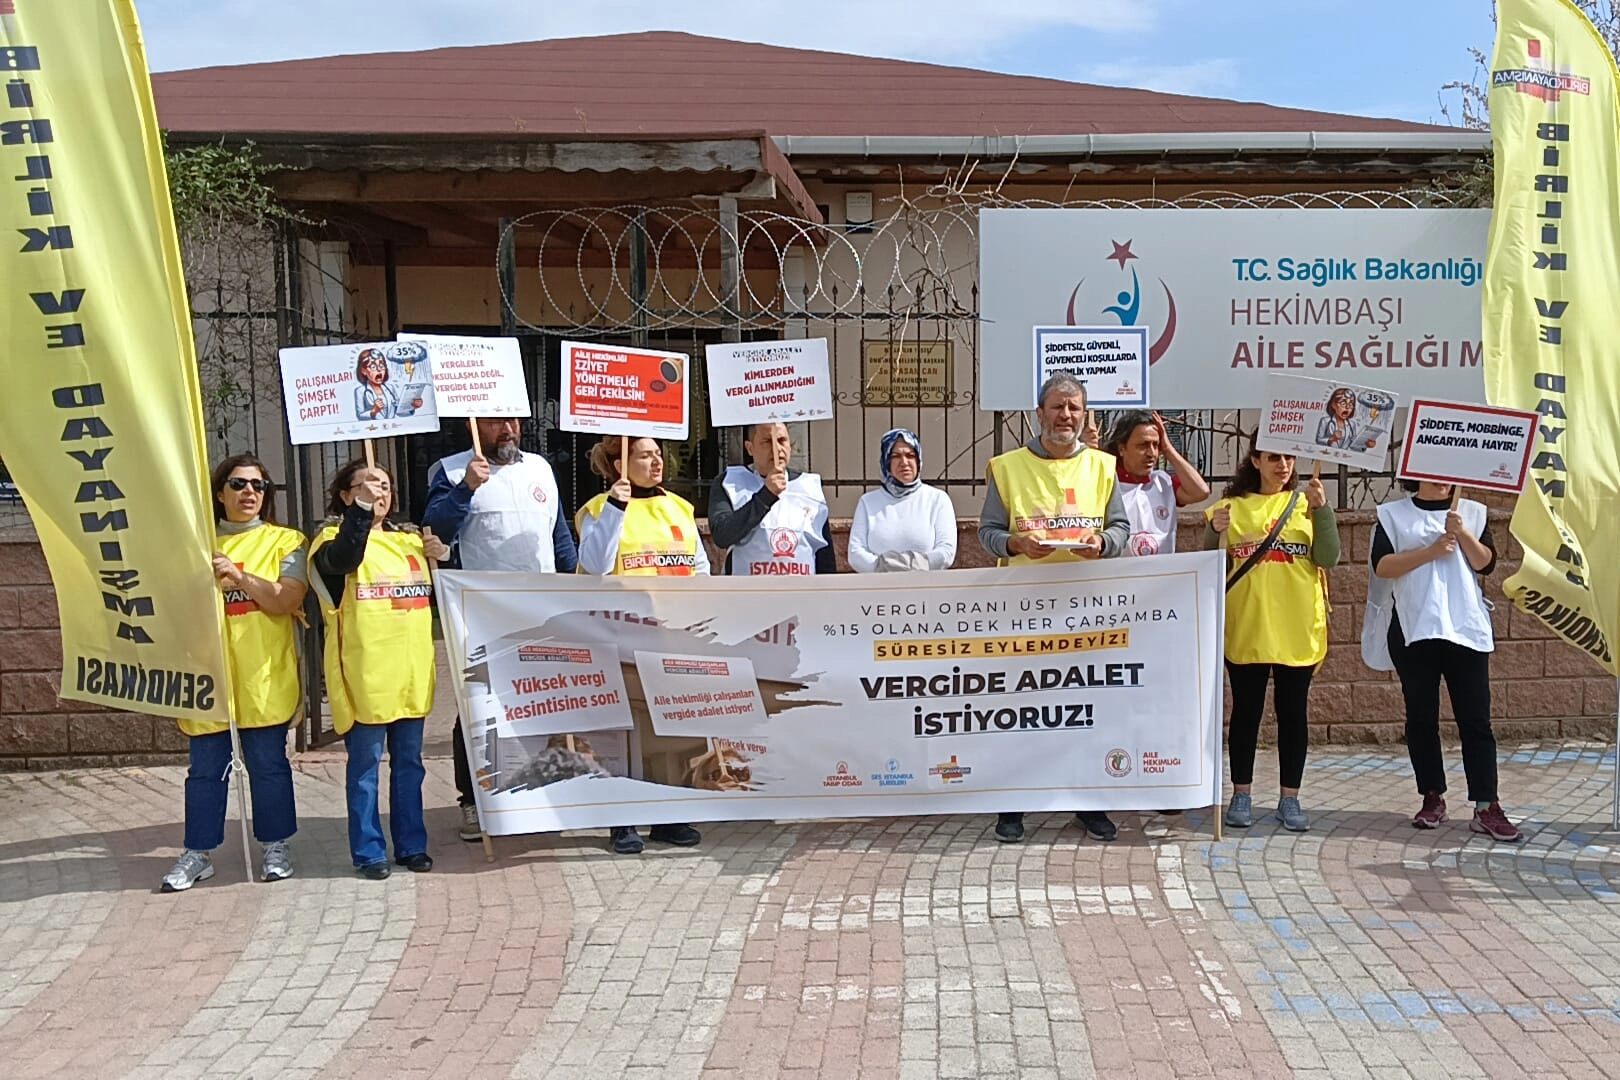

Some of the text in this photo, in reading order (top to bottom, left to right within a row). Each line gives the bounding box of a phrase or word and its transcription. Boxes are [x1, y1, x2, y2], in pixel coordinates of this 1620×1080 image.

[1232, 257, 1483, 287] T.C. Sağlık Bakanlığı
[1231, 293, 1403, 333] HEKİMBAŞI
[396, 347, 417, 357] 35%
[1045, 339, 1121, 353] ŞİDDETSİZ, GÜVENLİ,
[1231, 333, 1484, 368] AİLE SAĞLIĞI M
[1045, 353, 1137, 365] GÜVENCELİ KOŞULLARDA
[575, 371, 639, 388] YÖNETMELİĞİ
[744, 365, 795, 381] KİMLERDEN
[1086, 366, 1117, 375] YAPMAK
[295, 371, 353, 390] ÇALIŞANLARI
[726, 376, 815, 397] VERGİ ALINMADIĞINI
[297, 388, 337, 405] ŞİMŞEK
[575, 384, 645, 402] GERİ ÇEKİLSİN!
[749, 393, 795, 408] BİLİYORUZ
[300, 403, 340, 421] ÇARPTI!
[1273, 399, 1324, 411] ÇALIŞANLARI
[1420, 418, 1525, 438] ŞİDDETE, MOBBİNGE,
[1416, 434, 1518, 452] ANGARYAYA HAYIR!
[861, 594, 1136, 616] VERGİ ORANI ÜST SINIRI
[823, 609, 1178, 637] %15 OLANA DEK HER ÇARŞAMBA
[877, 632, 1127, 658] SÜRESİZ EYLEMDEYİZ!
[512, 670, 607, 695] Yüksek vergi
[859, 662, 1145, 699] VERGİDE ADALET
[504, 690, 620, 721] kesintisine son!
[654, 696, 671, 706] Aile
[663, 708, 696, 720] vergide
[697, 707, 725, 717] adalet
[914, 703, 1094, 736] İSTİYORUZ!
